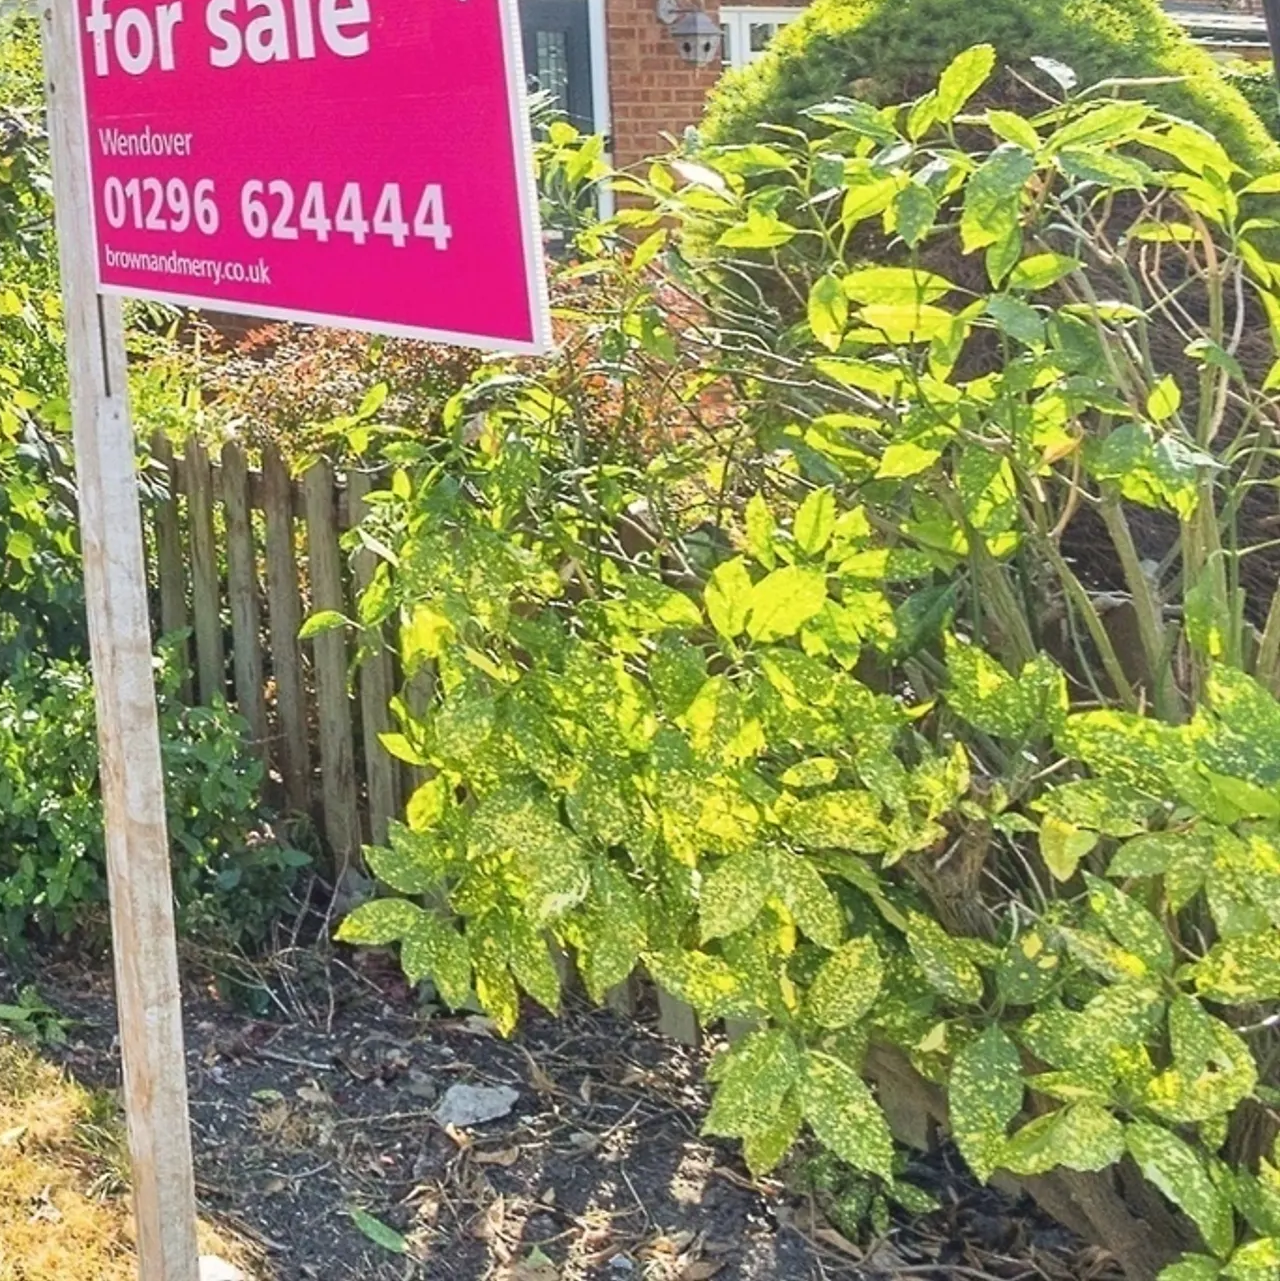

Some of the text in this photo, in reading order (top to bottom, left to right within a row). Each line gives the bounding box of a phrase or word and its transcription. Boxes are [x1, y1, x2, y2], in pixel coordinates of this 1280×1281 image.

[98, 126, 193, 157] Wendover
[104, 176, 453, 250] 01296 624444
[104, 244, 271, 285] brownandmerry.co.uk
